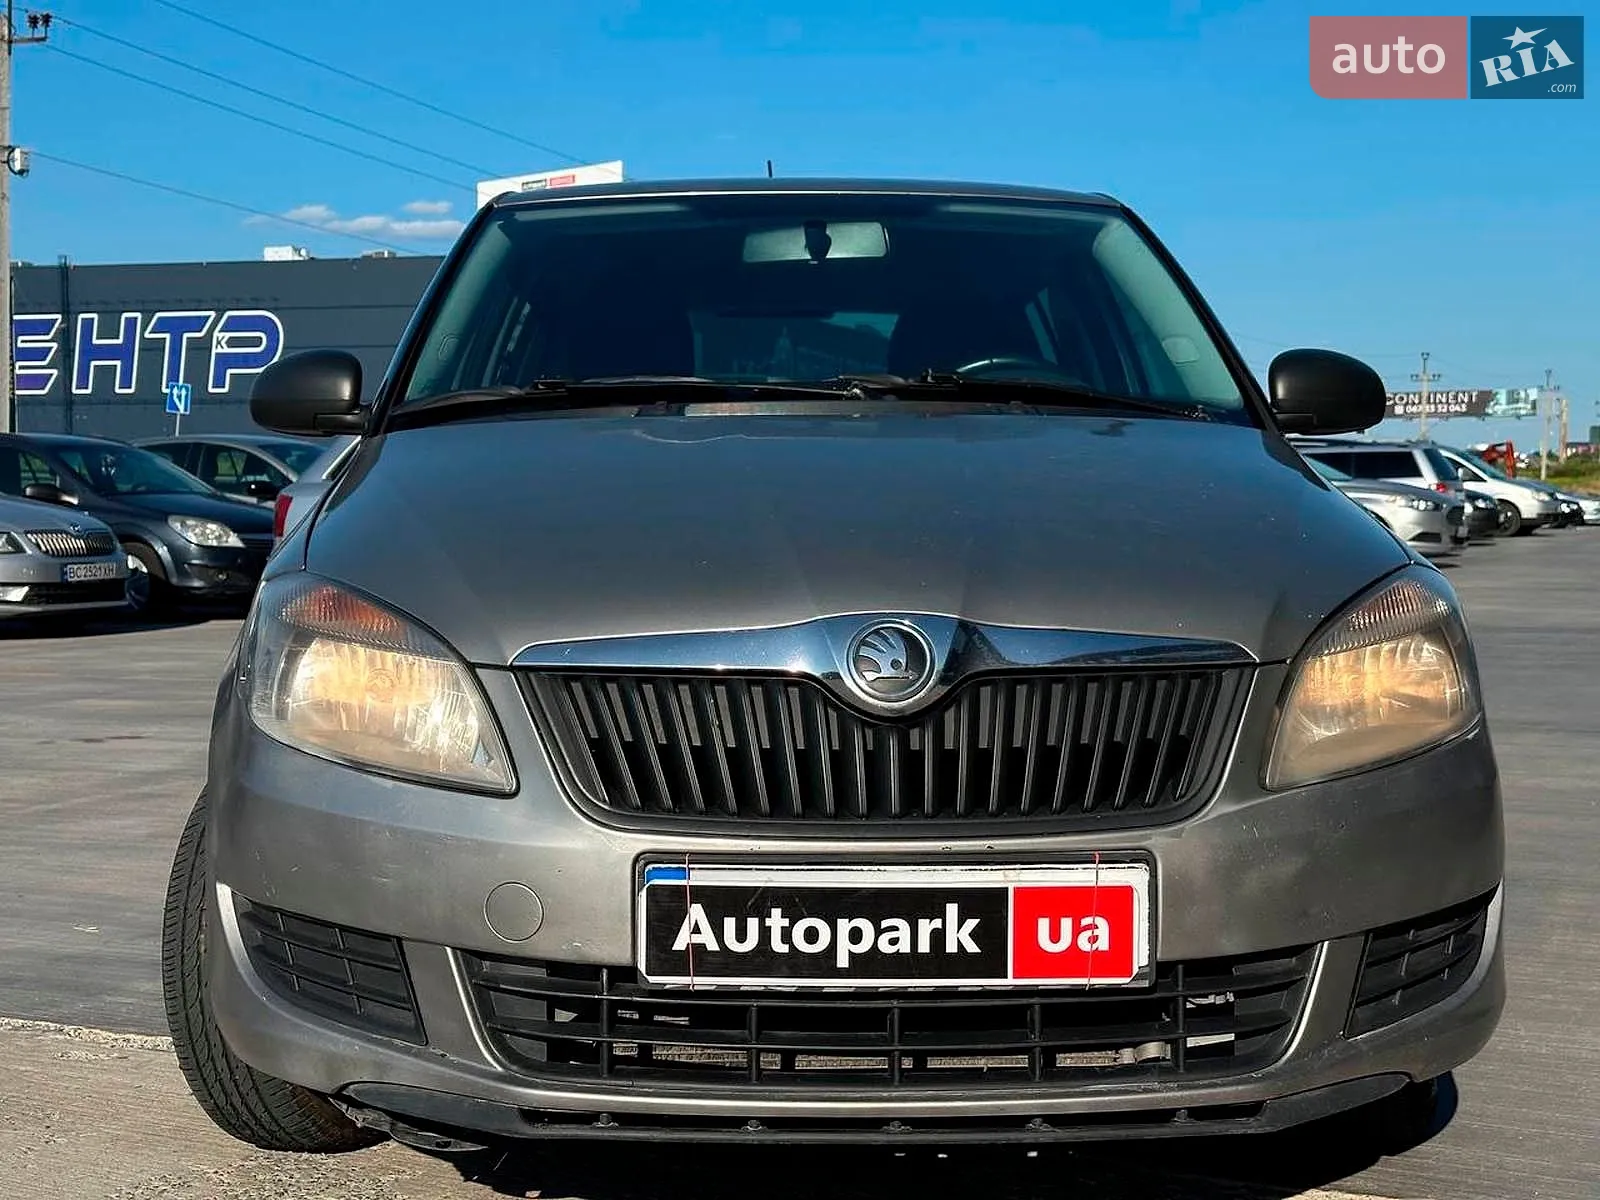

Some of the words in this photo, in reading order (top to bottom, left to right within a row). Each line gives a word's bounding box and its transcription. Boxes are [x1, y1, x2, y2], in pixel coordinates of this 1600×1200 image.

[1386, 391, 1478, 405] CONINENT
[671, 902, 982, 969] Autopark
[1037, 914, 1111, 954] ua
